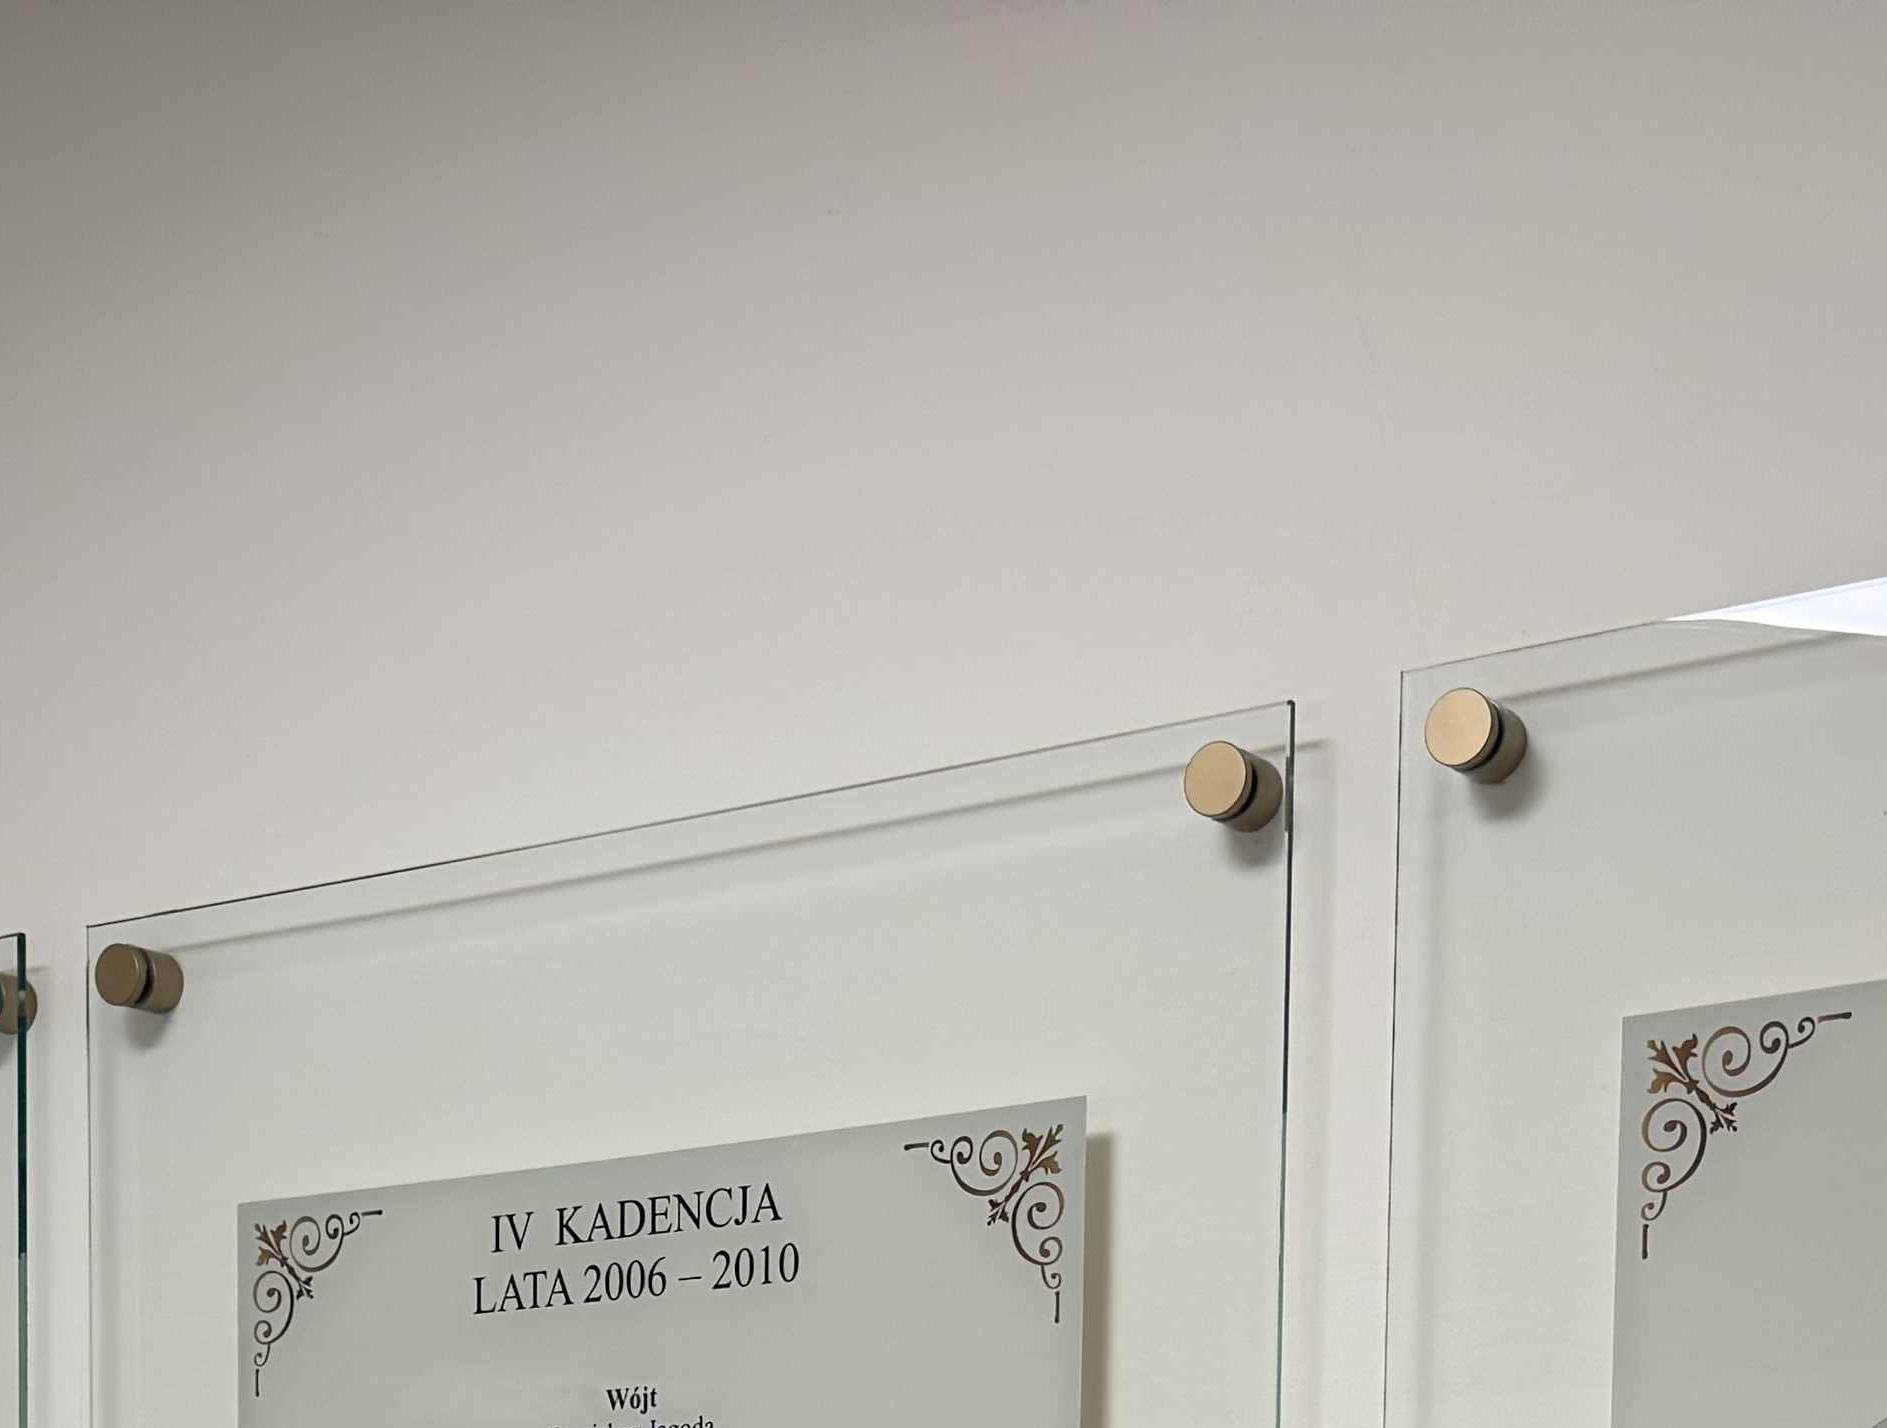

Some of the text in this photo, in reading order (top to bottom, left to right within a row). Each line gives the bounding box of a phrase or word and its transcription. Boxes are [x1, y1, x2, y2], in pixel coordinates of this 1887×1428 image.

[491, 1182, 783, 1253] IV KADENCJA
[473, 1268, 574, 1315] LATA
[583, 1256, 666, 1303] 2006
[712, 1242, 799, 1290] 2010
[606, 1386, 657, 1415] Wójt
